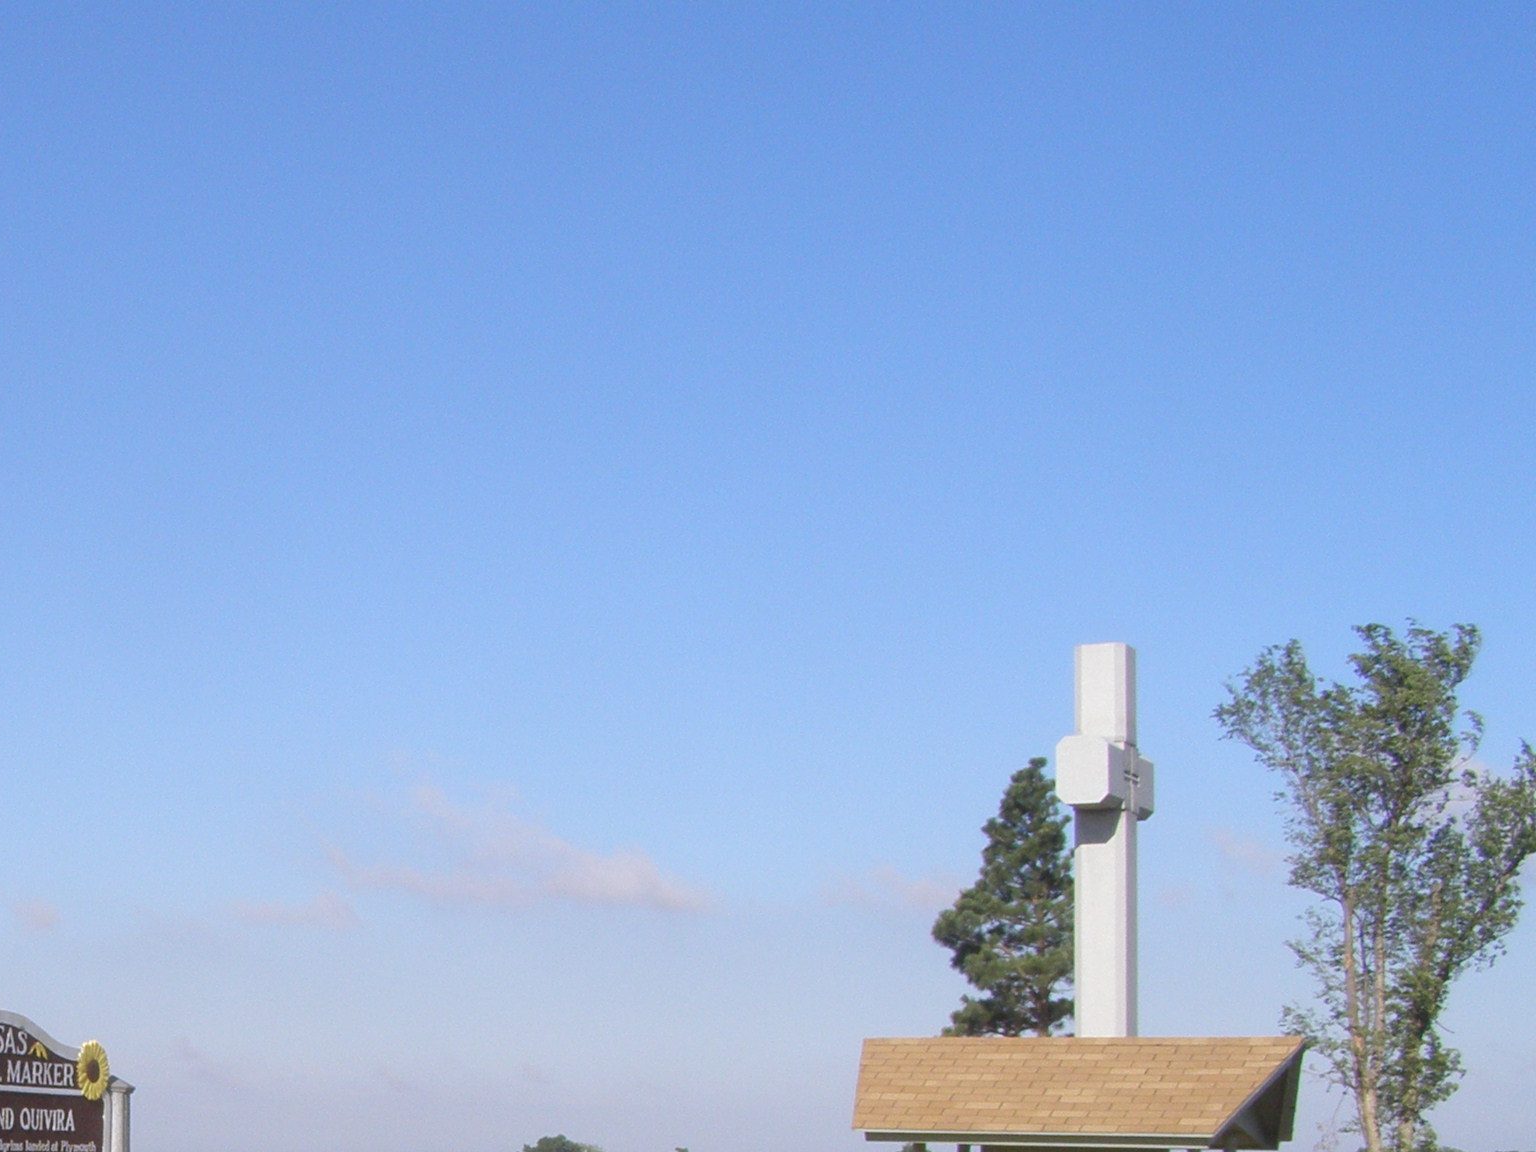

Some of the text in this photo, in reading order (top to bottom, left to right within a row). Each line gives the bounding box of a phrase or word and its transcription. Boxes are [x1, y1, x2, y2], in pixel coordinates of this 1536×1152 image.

[7, 1059, 75, 1087] MARKER
[20, 1107, 75, 1131] QUIVIRA
[26, 1140, 49, 1152] landed
